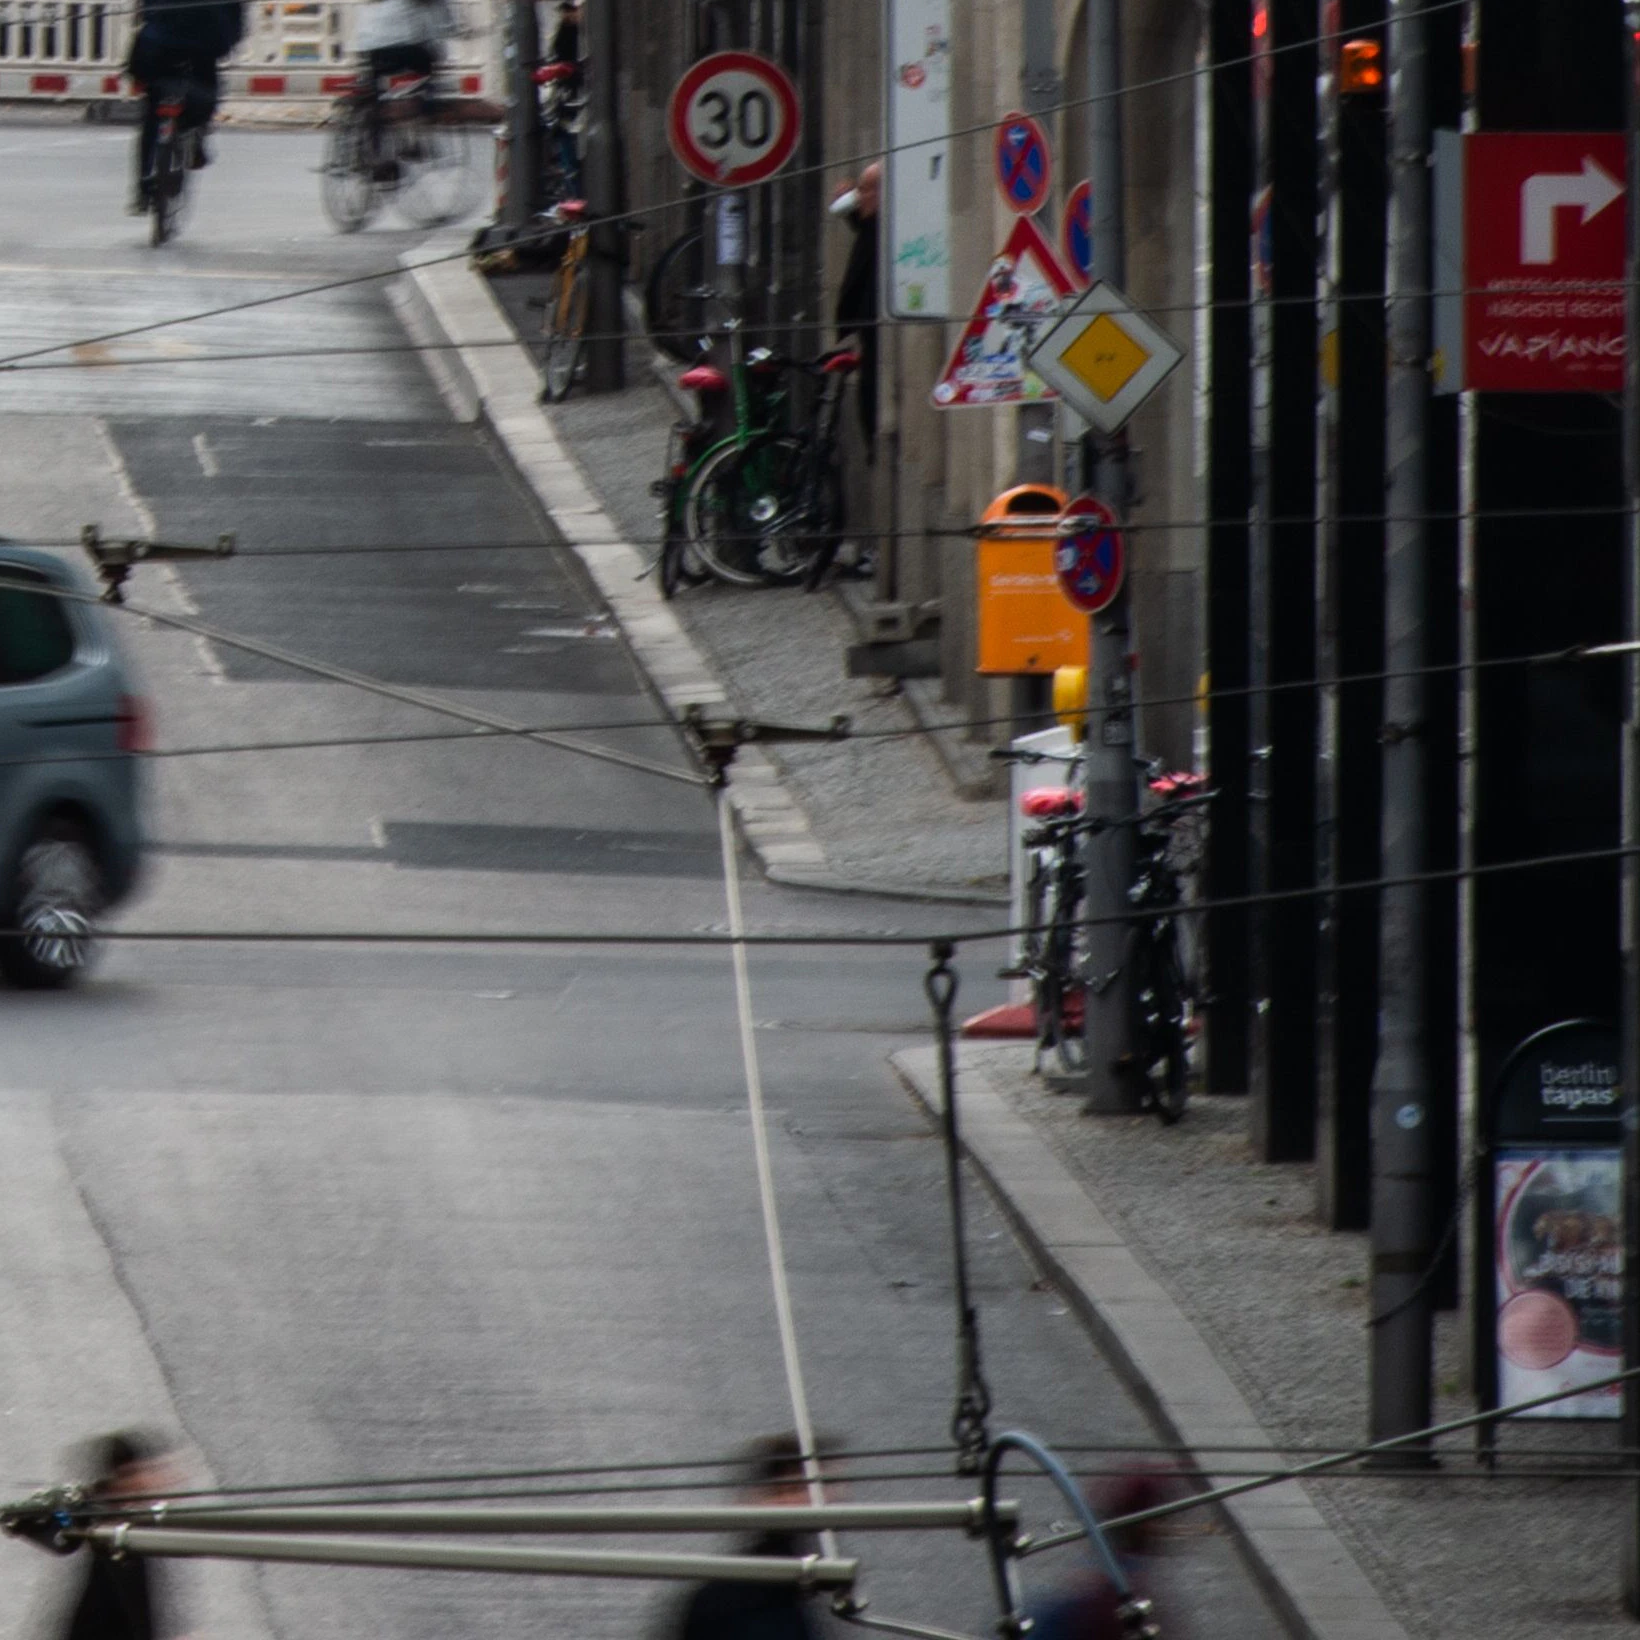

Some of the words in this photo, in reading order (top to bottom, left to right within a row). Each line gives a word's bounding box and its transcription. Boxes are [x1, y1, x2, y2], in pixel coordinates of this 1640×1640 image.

[696, 90, 771, 151] 30
[1569, 298, 1627, 319] RECHT
[1540, 1062, 1617, 1086] berlin
[1540, 1086, 1617, 1109] tapas
